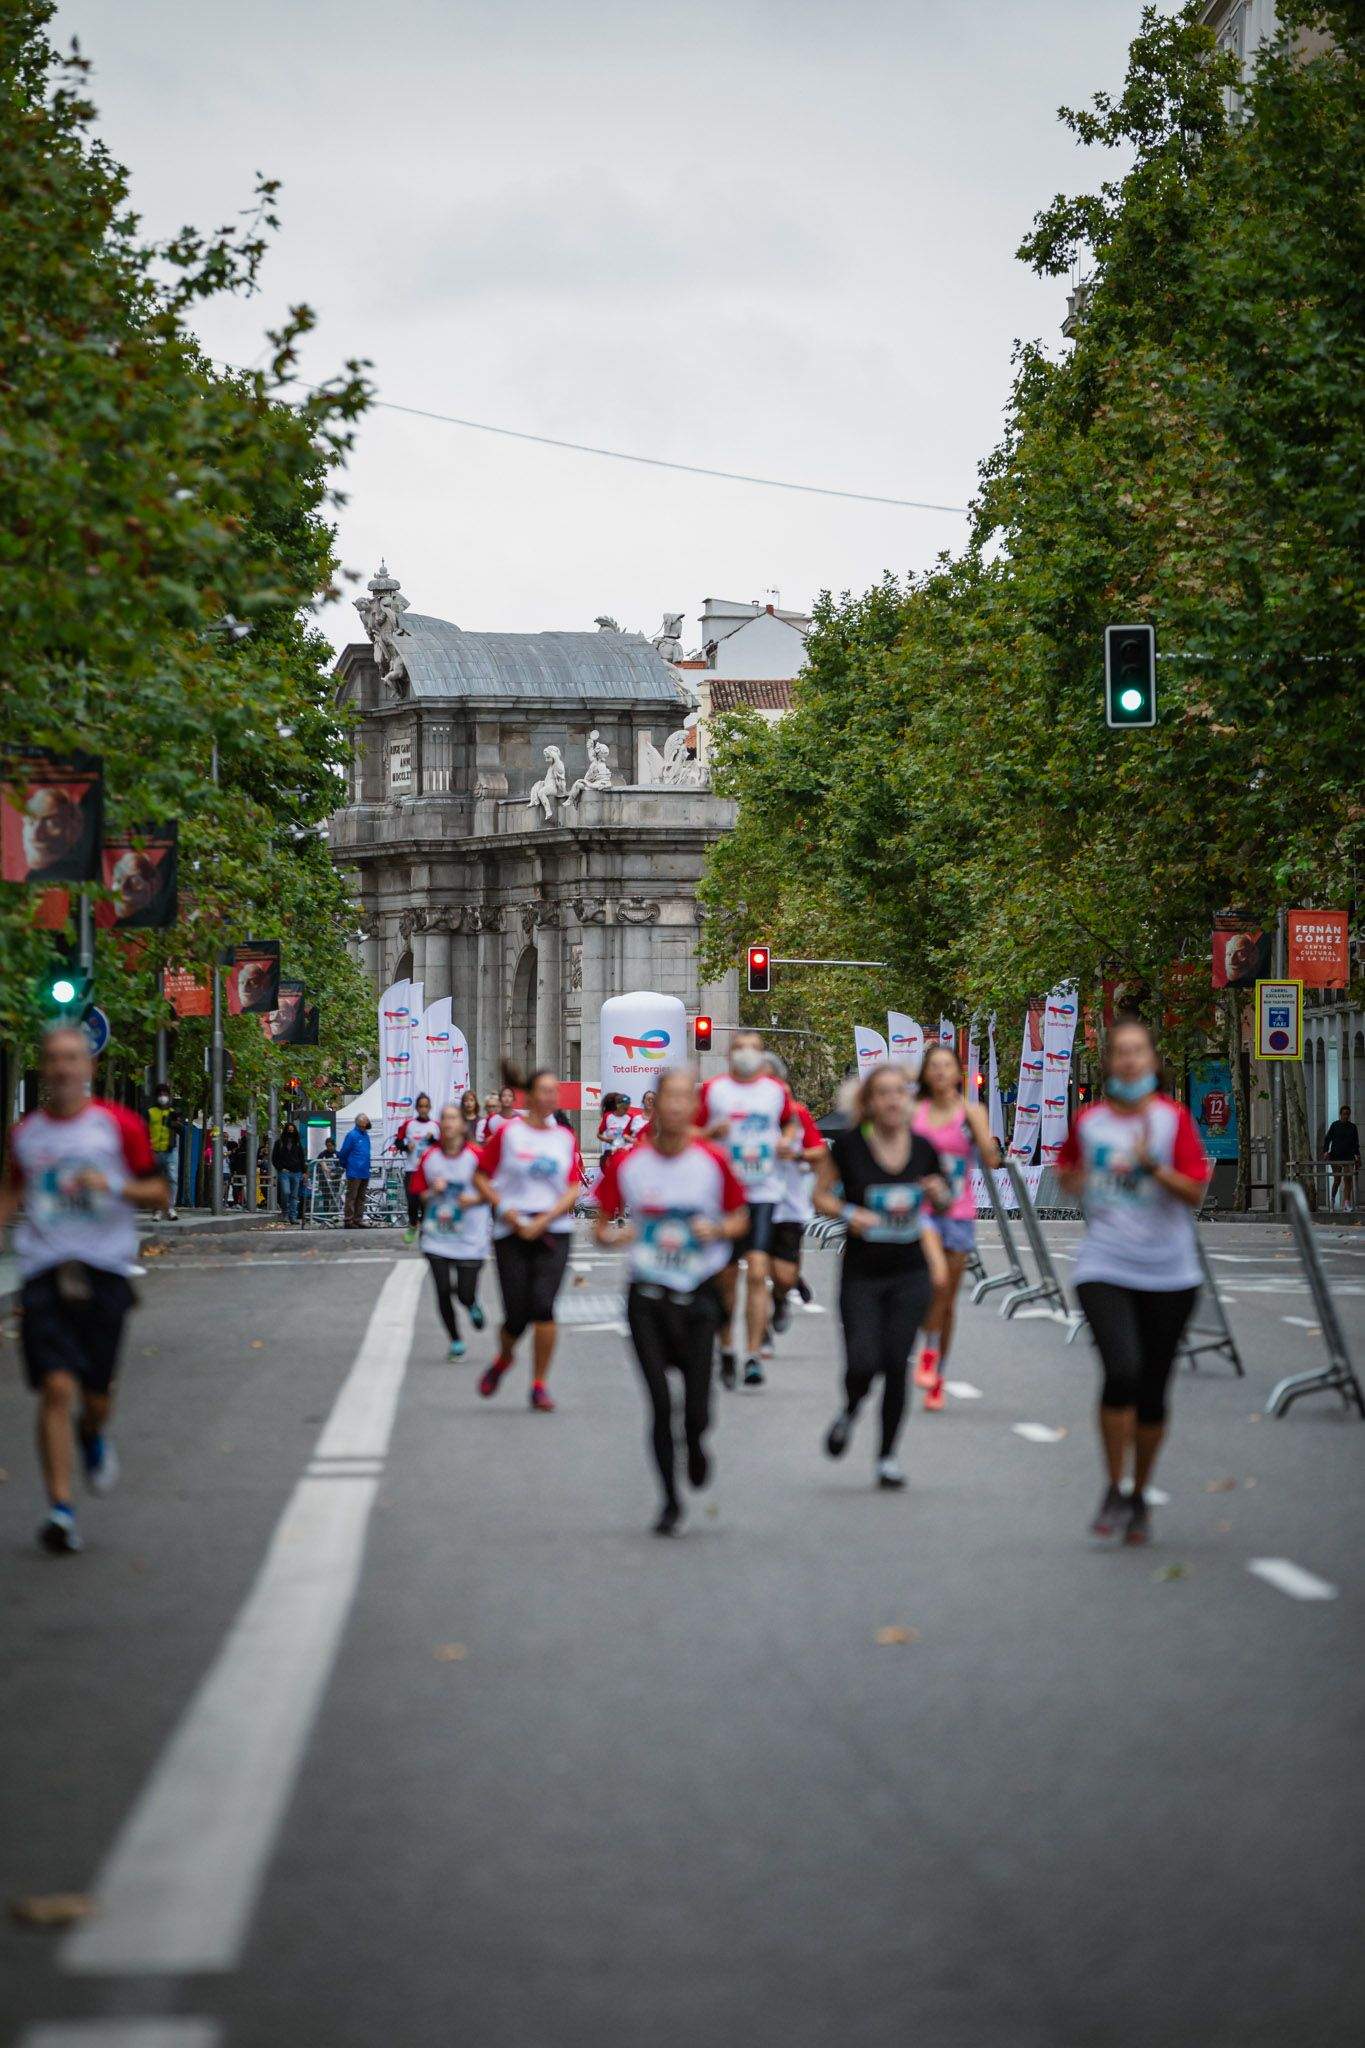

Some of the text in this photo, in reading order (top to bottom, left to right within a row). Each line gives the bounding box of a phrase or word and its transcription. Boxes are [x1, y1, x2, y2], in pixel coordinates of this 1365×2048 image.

[1296, 924, 1341, 934] FERNÁN
[1296, 933, 1341, 943] GÓMEZ
[1210, 1099, 1223, 1115] 12
